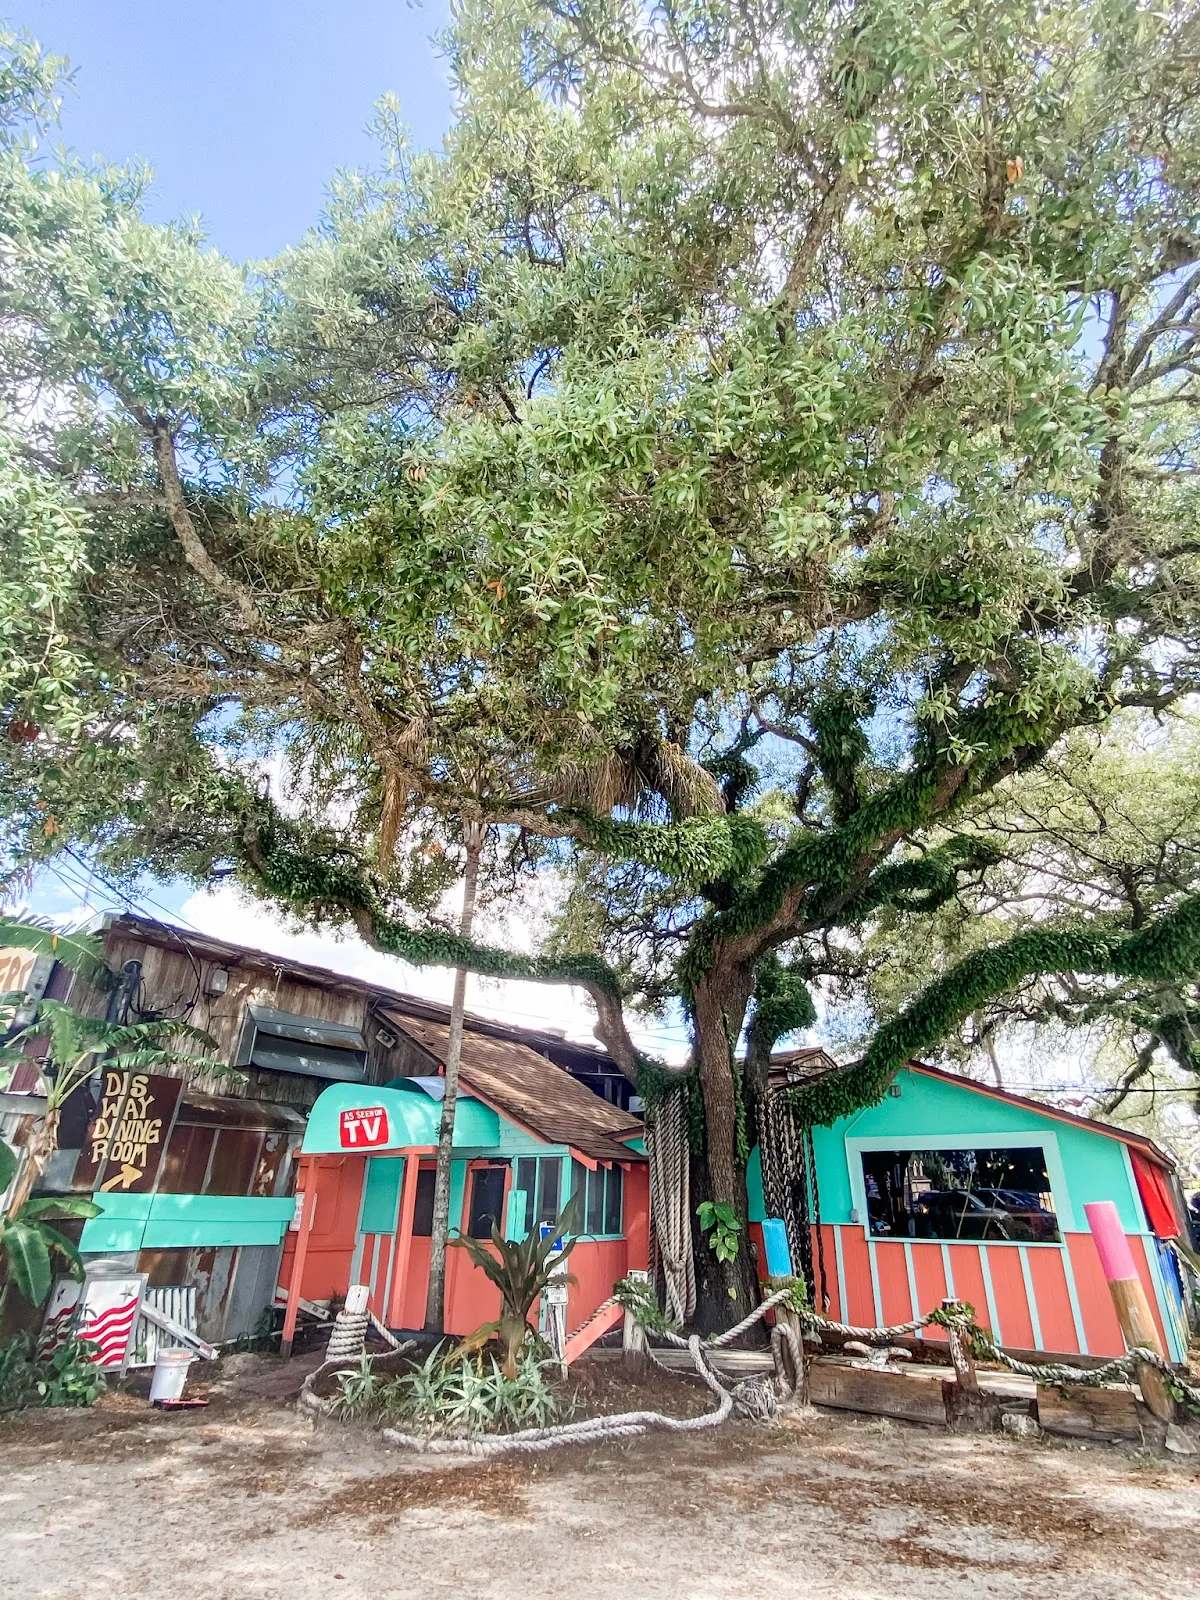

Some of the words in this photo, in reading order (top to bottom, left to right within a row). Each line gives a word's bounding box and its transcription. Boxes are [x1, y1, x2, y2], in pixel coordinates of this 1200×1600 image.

[105, 1071, 149, 1098] DIS
[102, 1095, 155, 1120] WAY
[344, 1112, 355, 1121] AS
[355, 1110, 374, 1119] SEEN
[92, 1118, 162, 1143] DINING
[343, 1117, 381, 1143] TV
[91, 1139, 147, 1167] ROOM
